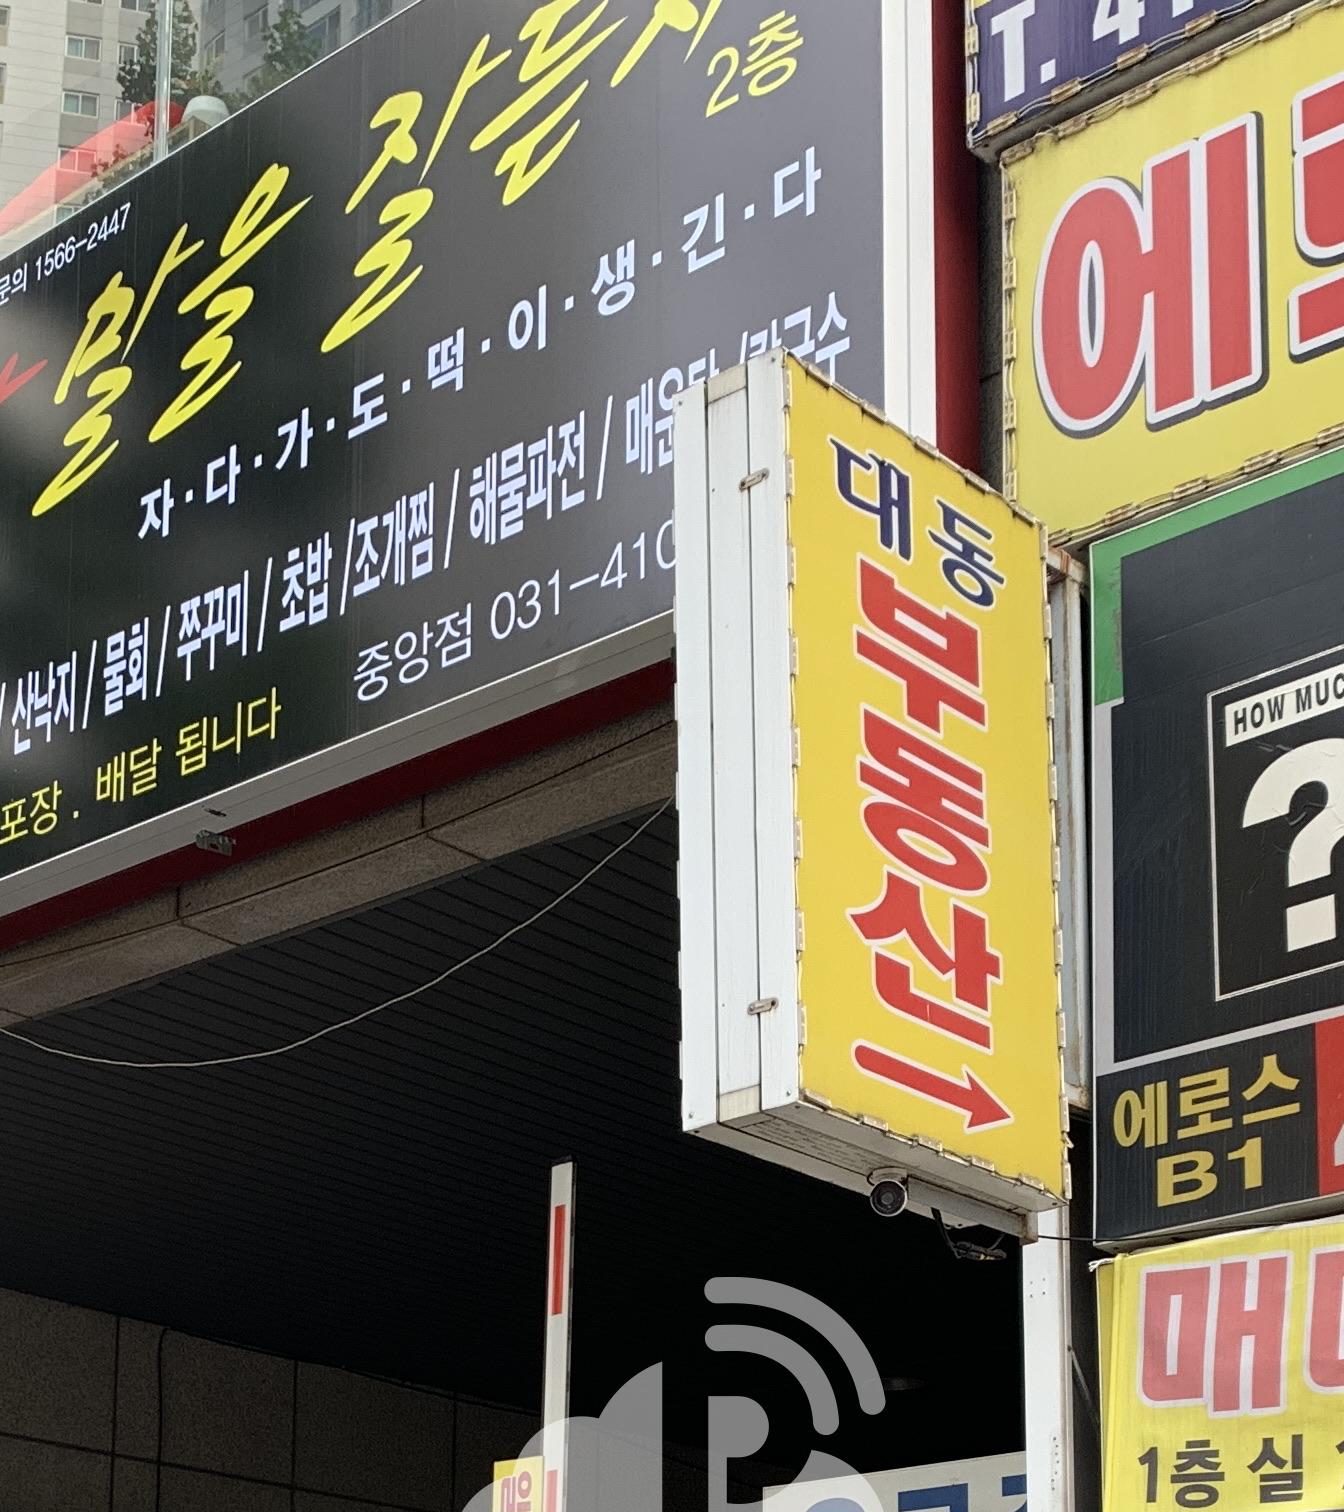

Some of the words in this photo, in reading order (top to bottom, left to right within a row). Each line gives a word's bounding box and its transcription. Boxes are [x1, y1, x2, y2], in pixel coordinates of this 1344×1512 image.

[705, 11, 805, 119] 2층
[34, 202, 132, 283] 1566-2447
[828, 434, 1005, 608] 대동
[11, 649, 78, 756] 산낙지
[103, 615, 150, 717] 물회
[279, 530, 334, 632] 초밥
[468, 410, 587, 546] 해물파전
[352, 602, 474, 703] 중앙점
[96, 738, 163, 804] 배달
[175, 687, 283, 777] 됩니다
[1231, 688, 1287, 737] HOW
[846, 556, 1004, 1052] 부동산
[1112, 1055, 1302, 1151] 에로스
[1155, 1139, 1264, 1207] B1
[1137, 1437, 1227, 1508] 1층
[1246, 1432, 1307, 1499] 실
